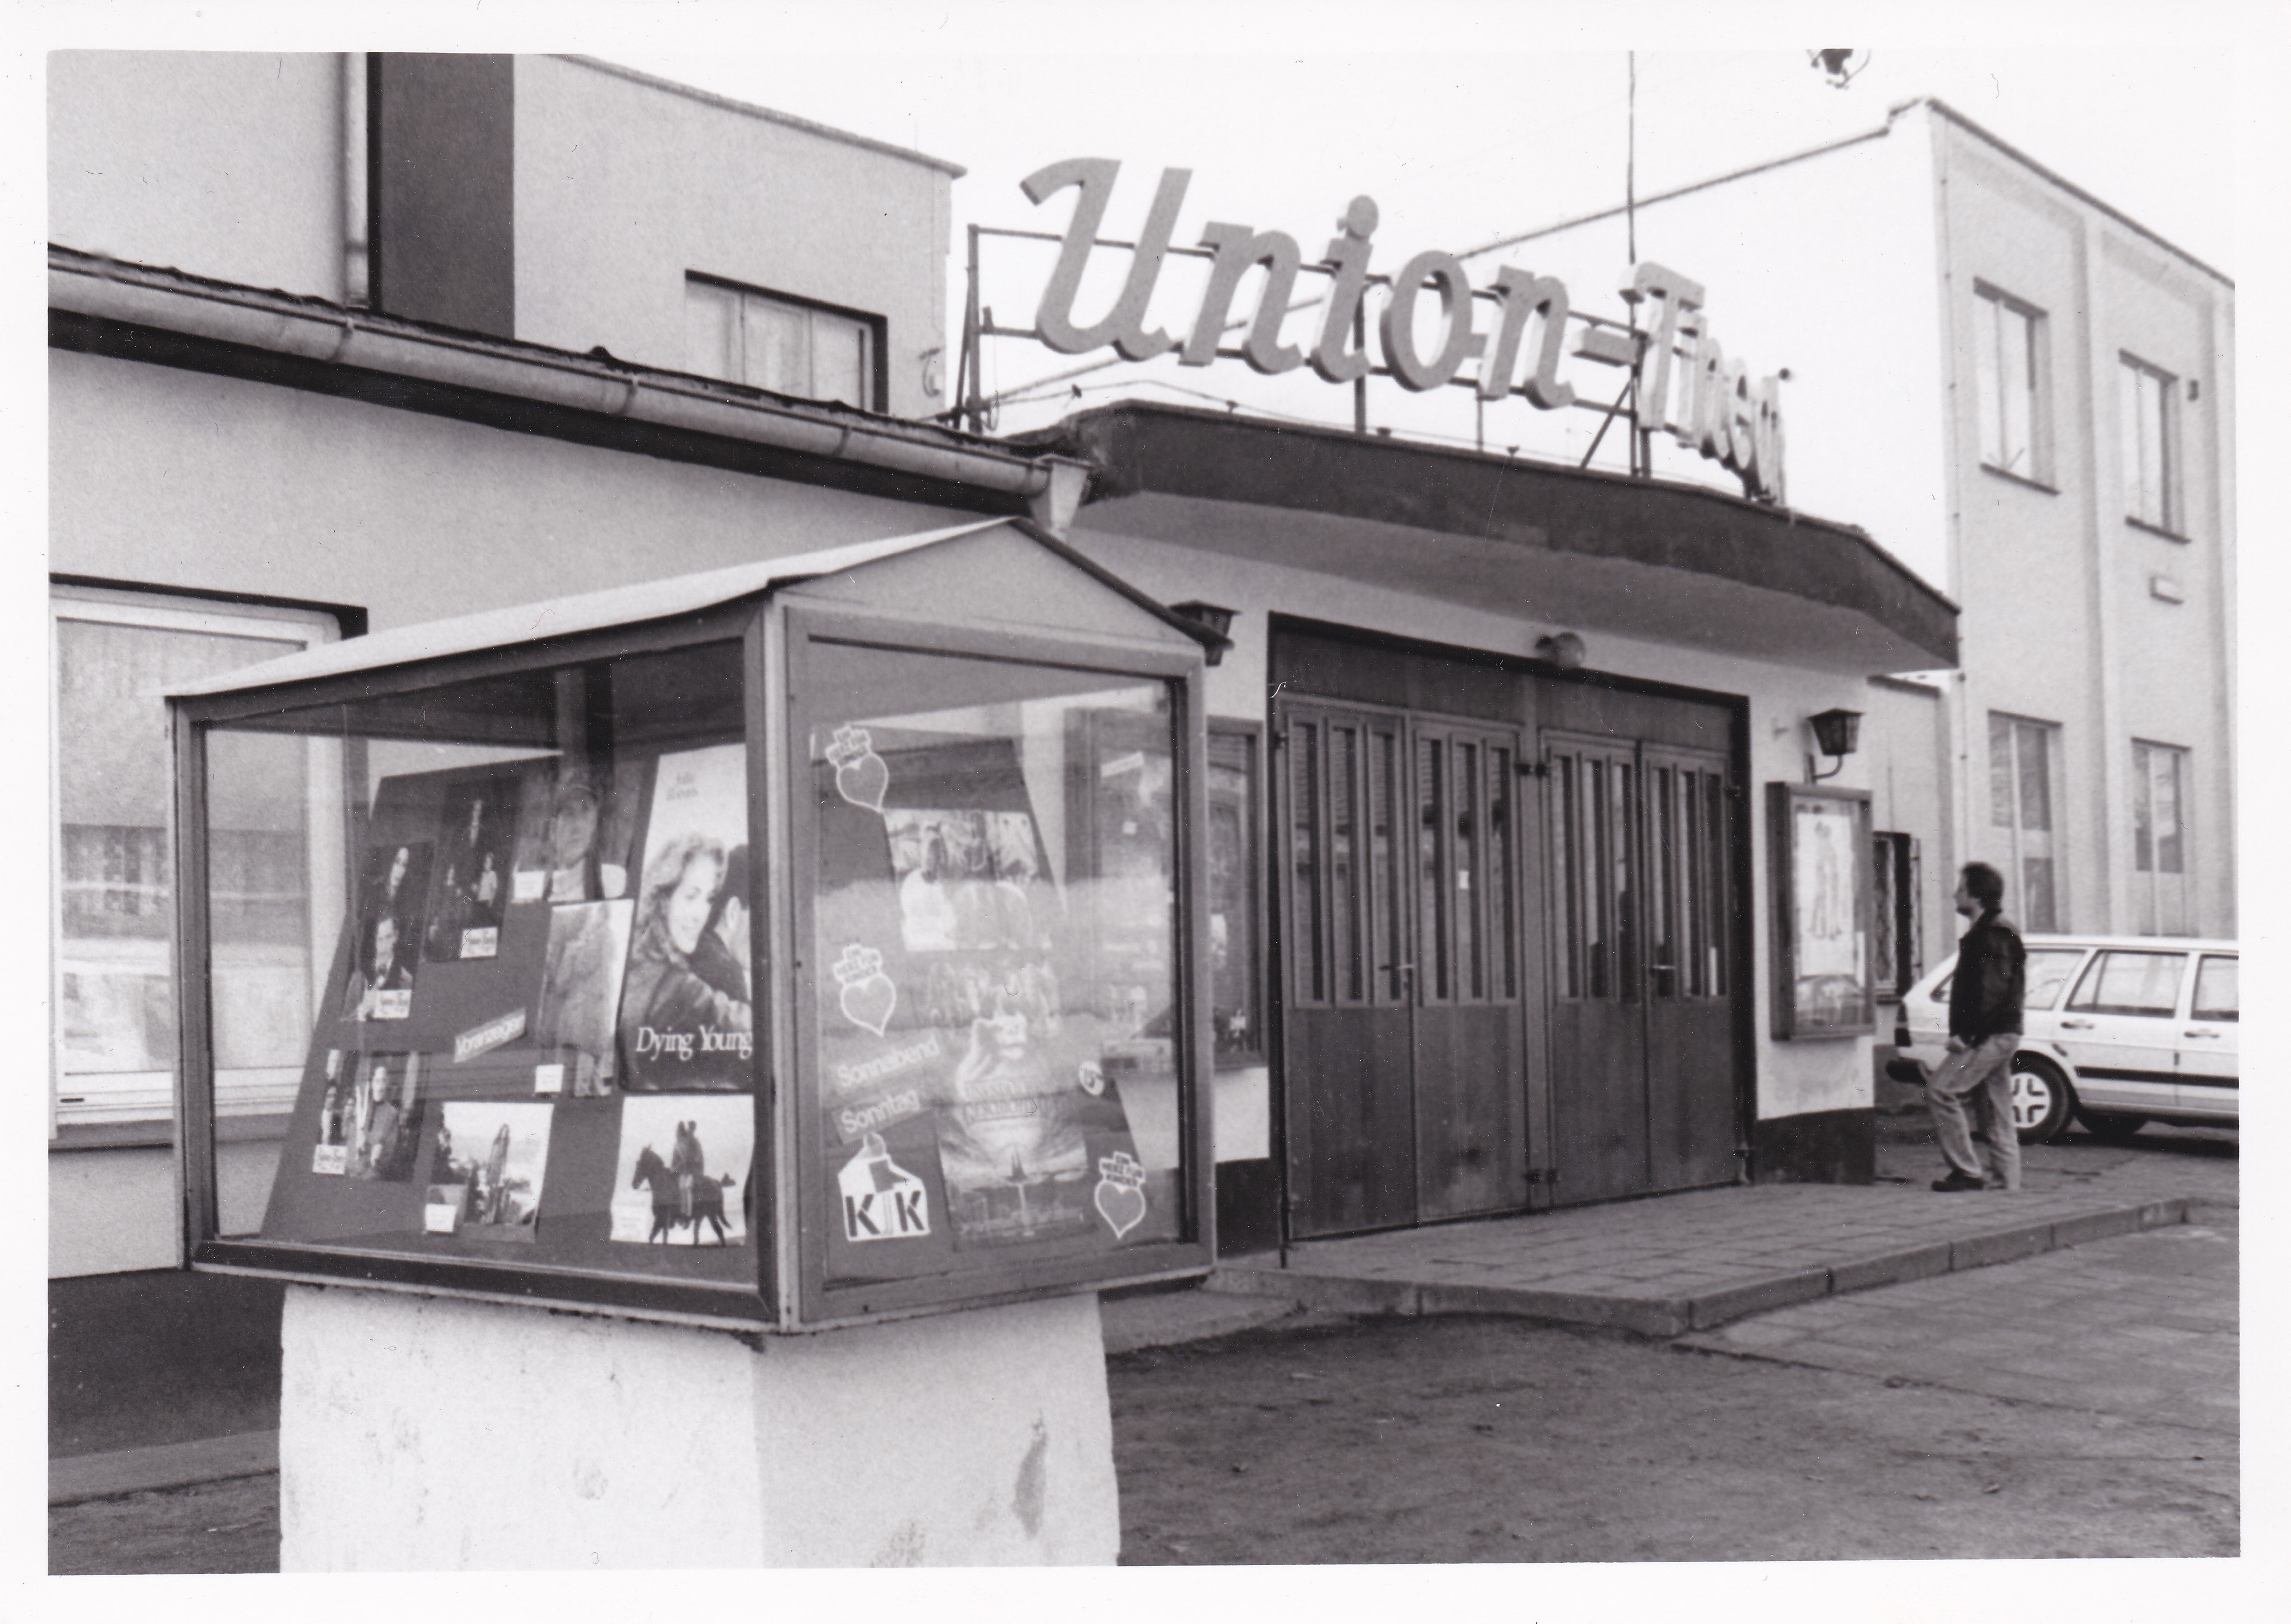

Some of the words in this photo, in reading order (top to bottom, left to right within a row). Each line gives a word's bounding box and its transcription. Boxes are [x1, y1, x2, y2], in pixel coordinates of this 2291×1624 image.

[636, 1026, 694, 1061] Dying
[699, 1024, 753, 1060] Young
[838, 1034, 940, 1087] Sonnabend
[841, 1089, 921, 1132] Sonntag
